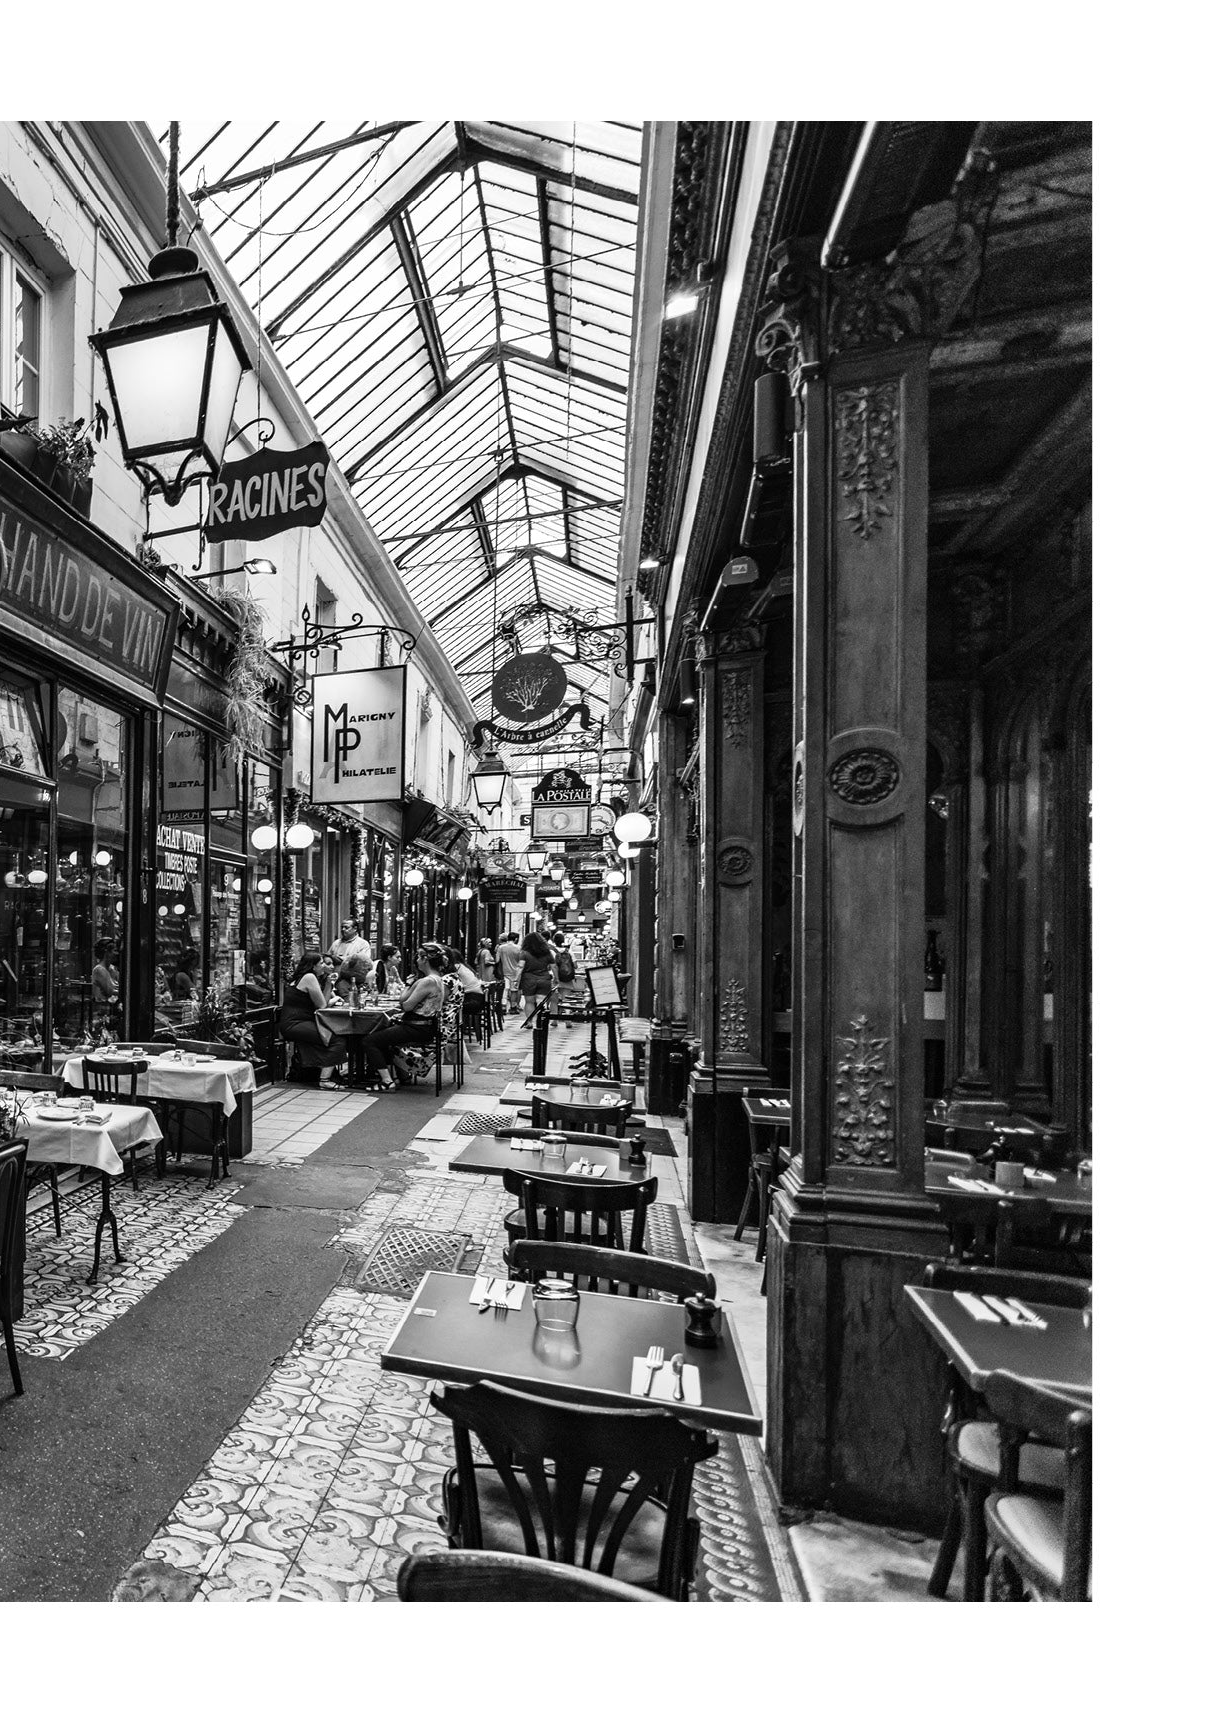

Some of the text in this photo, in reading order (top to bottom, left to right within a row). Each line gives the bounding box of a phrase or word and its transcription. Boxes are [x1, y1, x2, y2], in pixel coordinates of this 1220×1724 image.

[208, 462, 325, 526] RACINES
[81, 574, 122, 649] DE
[122, 600, 161, 673] VIN
[493, 726, 525, 741] L'Arbre
[535, 718, 568, 738] cannelle
[531, 791, 545, 801] LA
[547, 790, 591, 801] POSTALE
[156, 825, 205, 855] ACHAT VENTE
[164, 851, 198, 874] TIMBRES POSTE
